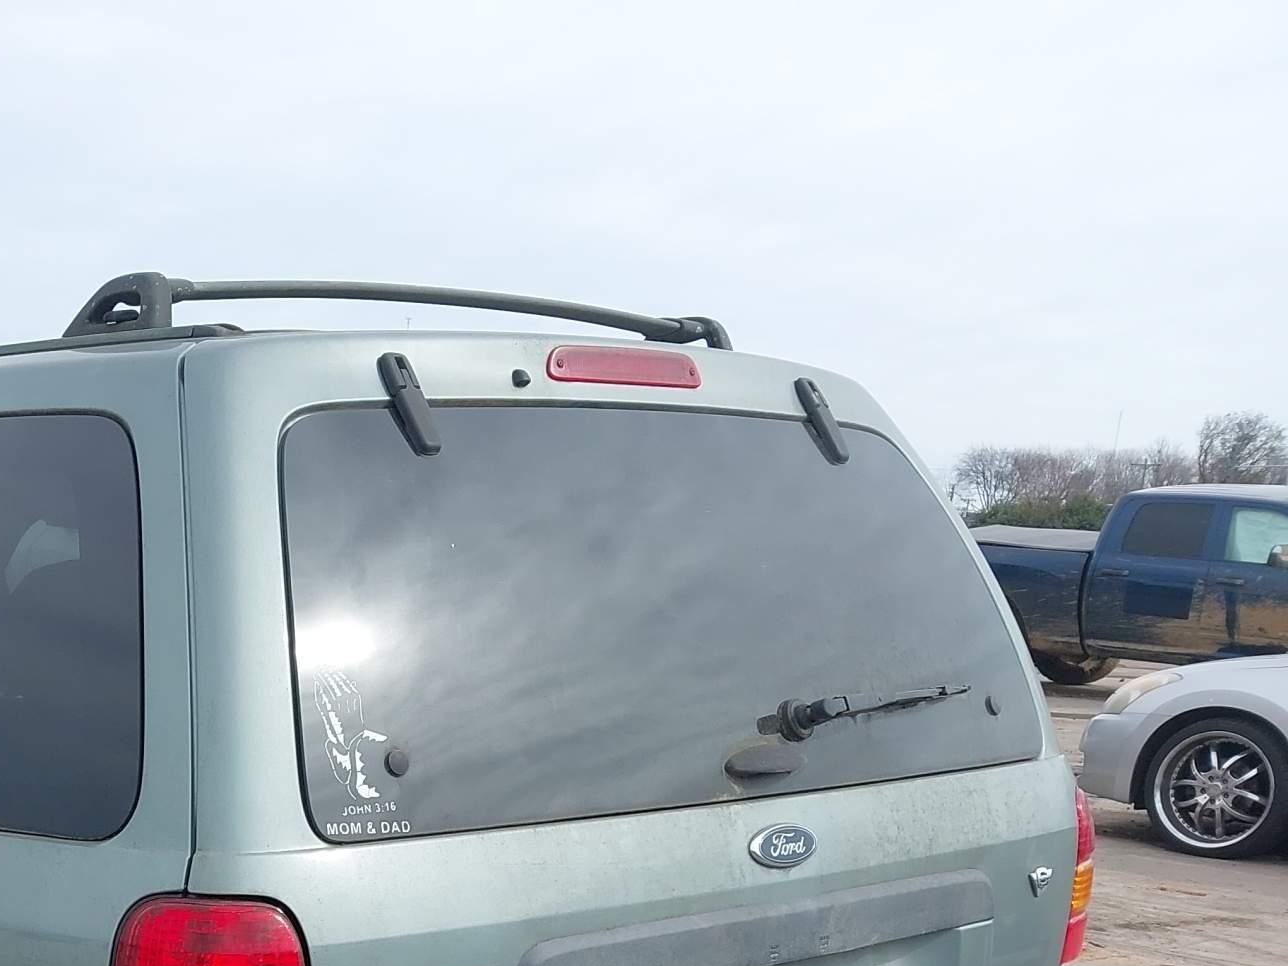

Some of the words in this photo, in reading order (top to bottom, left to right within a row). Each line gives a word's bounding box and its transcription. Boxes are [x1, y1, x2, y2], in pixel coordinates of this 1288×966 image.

[342, 804, 372, 816] JOHN
[374, 801, 397, 813] 3:16
[326, 822, 362, 835] MOM
[367, 821, 377, 834] &
[380, 820, 411, 834] DAD
[770, 832, 806, 857] Ford
